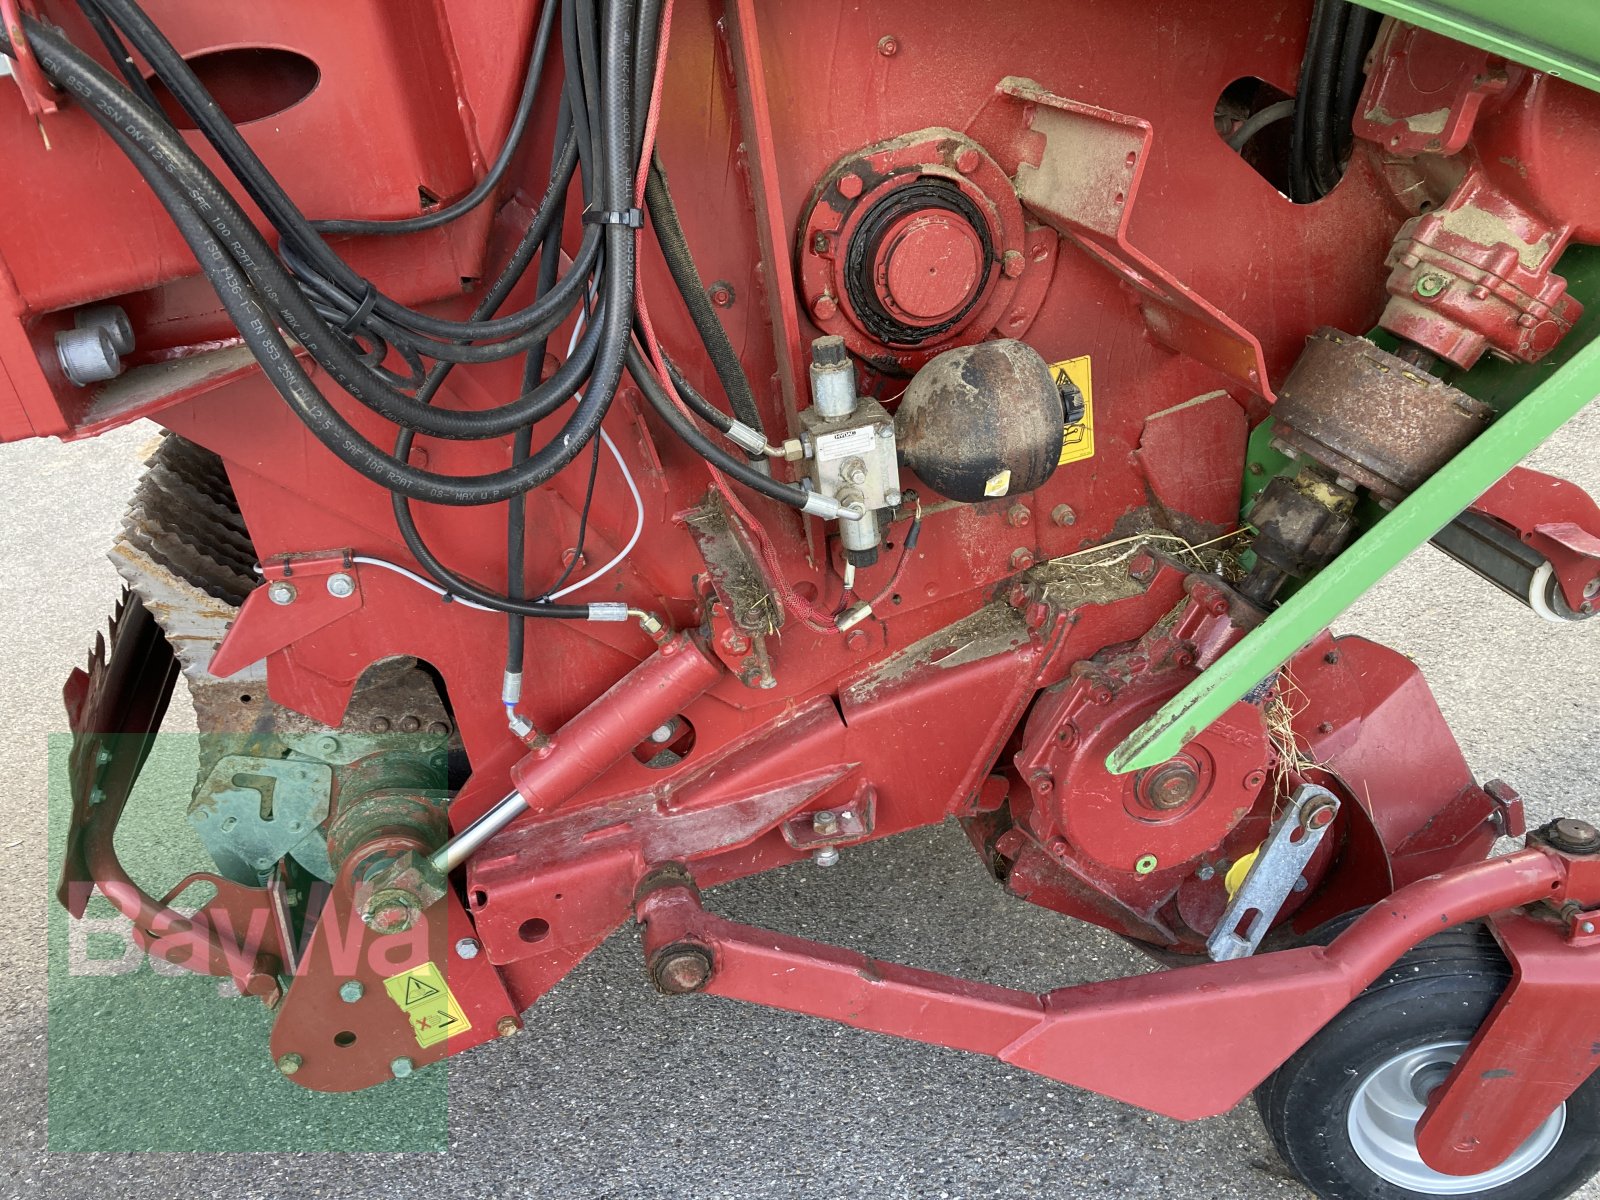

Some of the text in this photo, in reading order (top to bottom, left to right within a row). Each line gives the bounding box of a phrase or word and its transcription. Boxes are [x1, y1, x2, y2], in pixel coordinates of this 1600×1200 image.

[42, 57, 62, 74] EN
[66, 75, 92, 98] 853
[96, 100, 122, 122] 2SN
[125, 124, 144, 141] DN
[146, 145, 177, 173] 12.5
[188, 188, 211, 212] SAE
[211, 217, 231, 237] 100
[230, 241, 257, 268] R2AT
[280, 309, 300, 329] MAX
[622, 106, 632, 148] FLEXOR
[624, 167, 634, 199] ITALY
[204, 238, 223, 261] ISO
[250, 319, 266, 335] EN
[262, 340, 280, 361] 853
[277, 364, 296, 386] 2SN
[295, 387, 310, 401] DN
[308, 405, 334, 430] 12.5
[364, 458, 383, 474] 100
[386, 471, 414, 489] R2AT
[455, 492, 476, 501] MAX
[511, 478, 535, 494] 27.5
[537, 467, 555, 481] MPa
